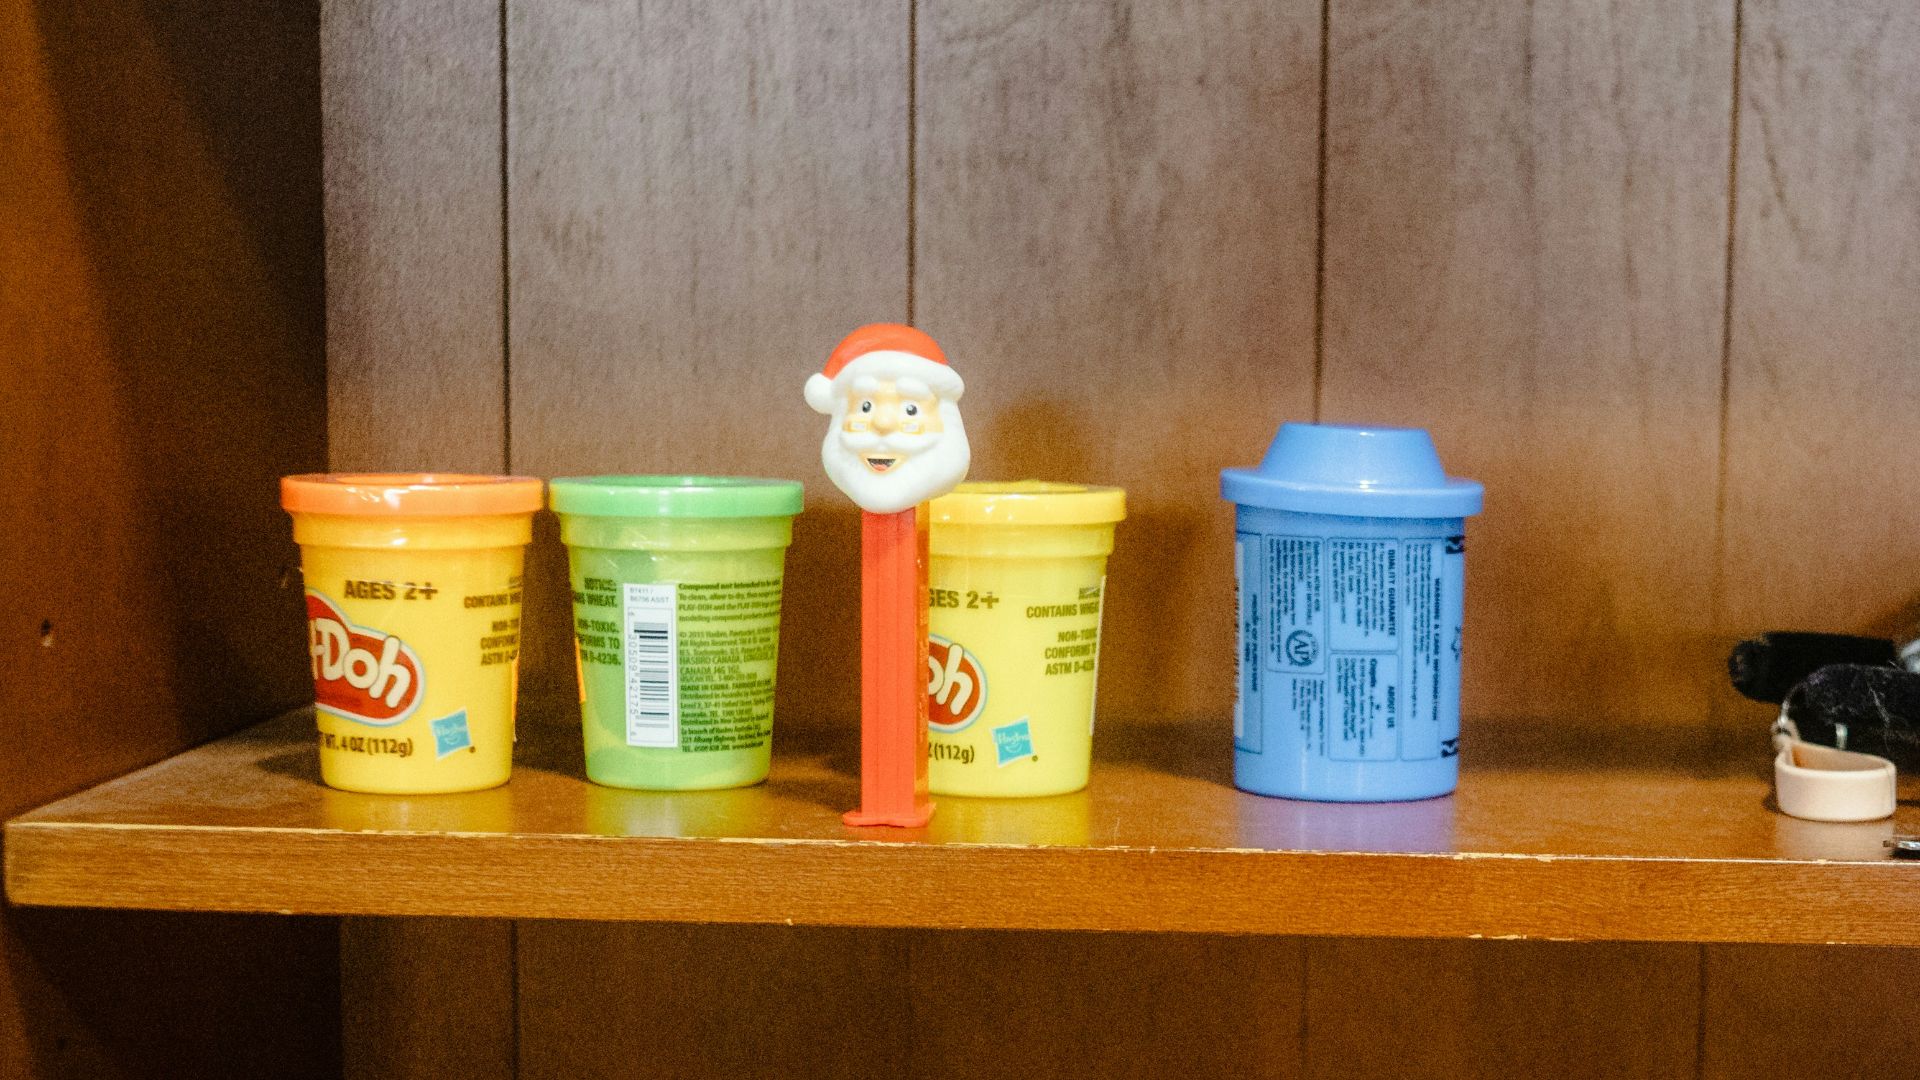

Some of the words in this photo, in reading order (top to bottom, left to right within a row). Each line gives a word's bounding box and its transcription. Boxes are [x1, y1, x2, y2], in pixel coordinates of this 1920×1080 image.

[1388, 549, 1396, 584] QUALITY
[344, 579, 396, 600] AGES
[404, 581, 438, 600] 2+
[966, 590, 1000, 610] 2+
[1026, 604, 1077, 619] CONTAINS
[1388, 587, 1396, 637] GUARANTEE
[1045, 661, 1073, 676] ASTM
[1387, 686, 1395, 714] ABOUT
[367, 738, 414, 758] (112g)
[934, 743, 975, 764] (112g)
